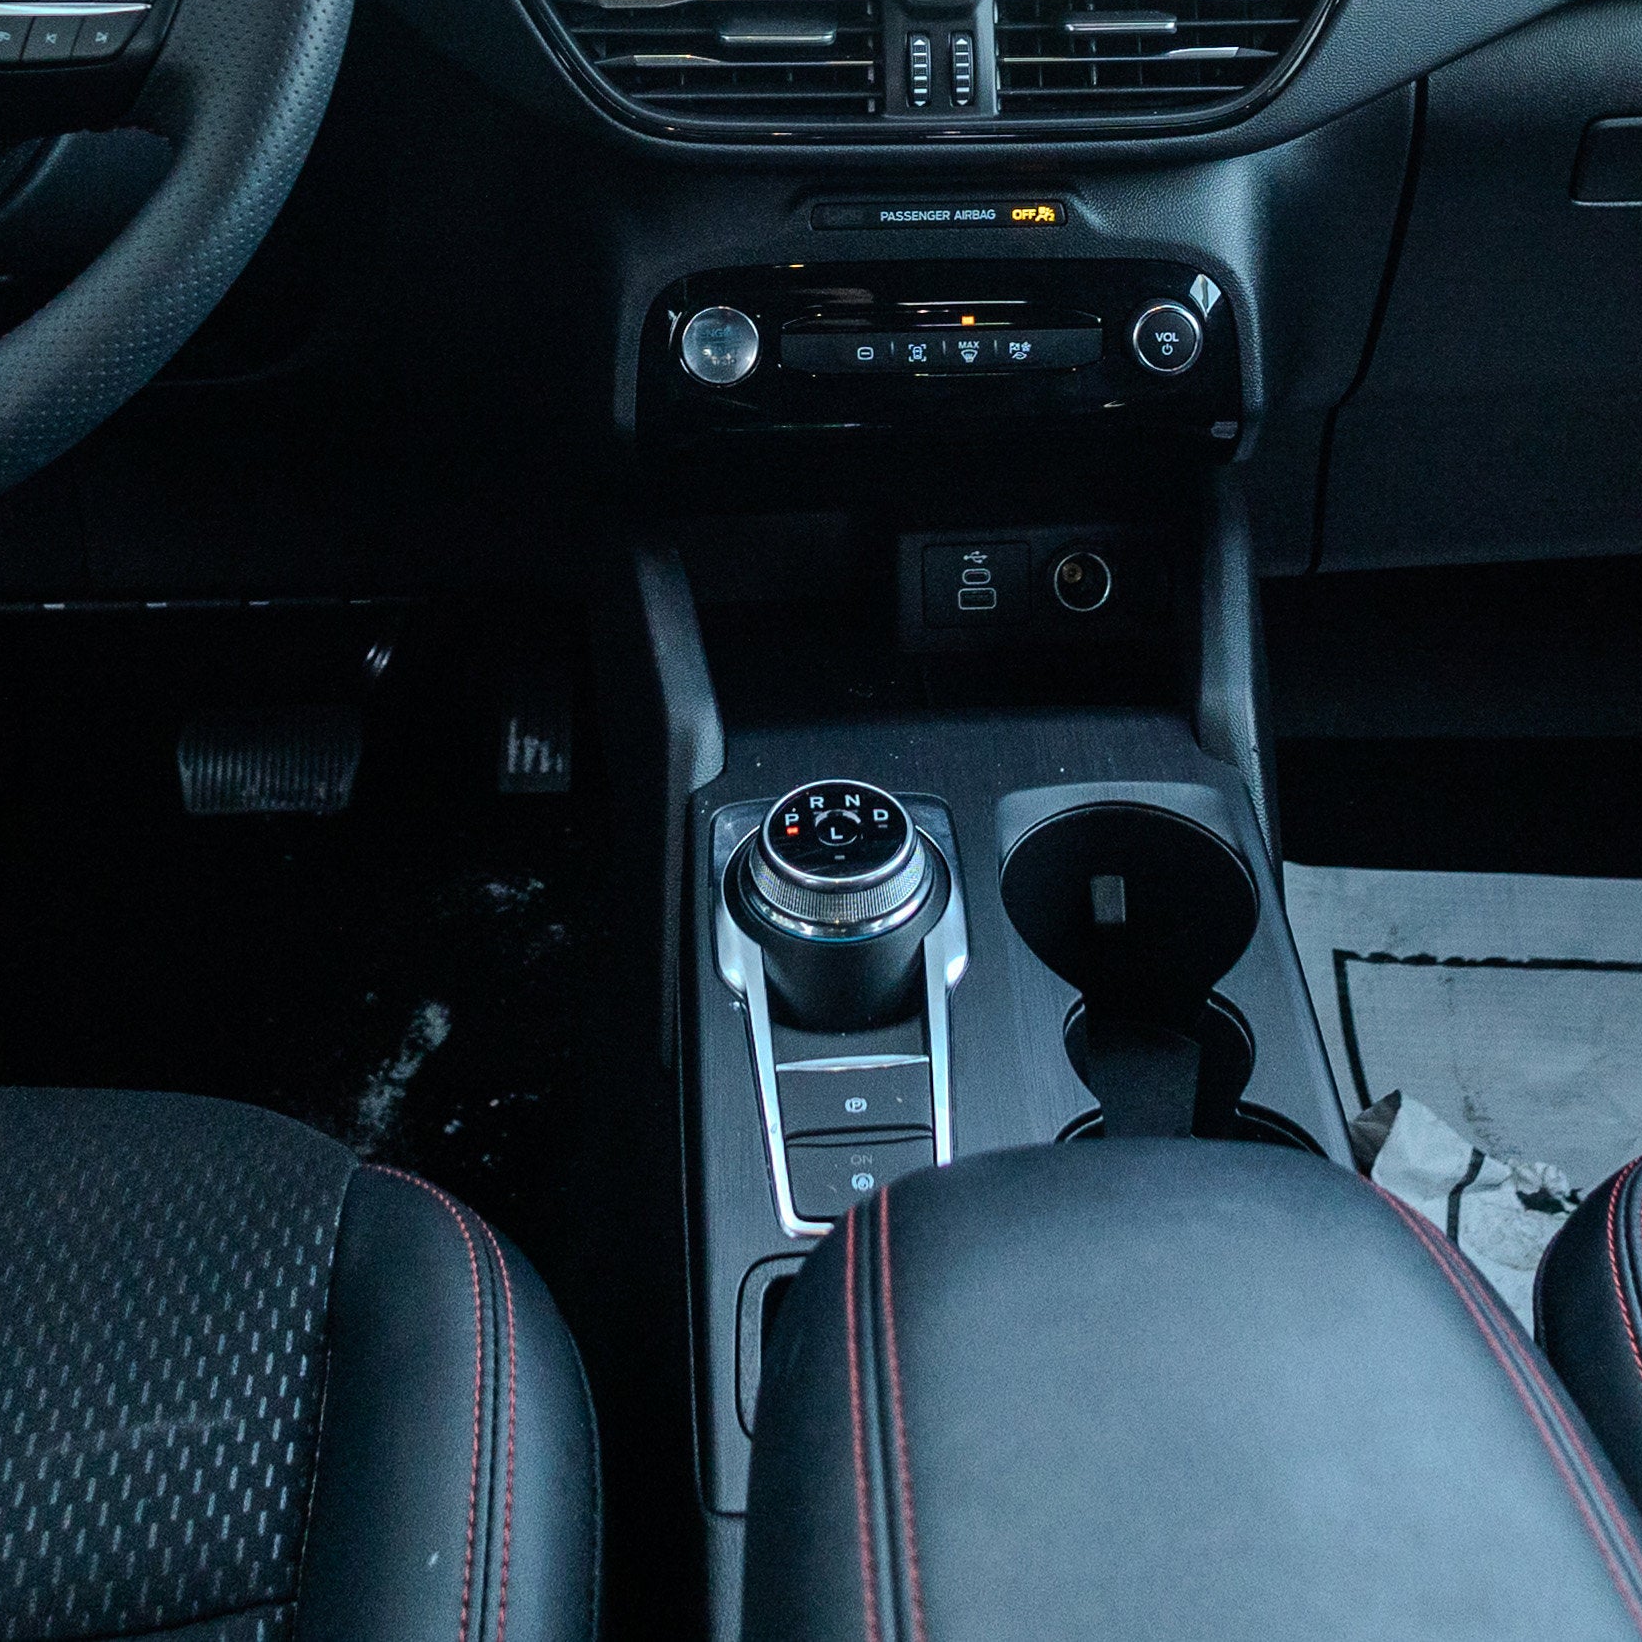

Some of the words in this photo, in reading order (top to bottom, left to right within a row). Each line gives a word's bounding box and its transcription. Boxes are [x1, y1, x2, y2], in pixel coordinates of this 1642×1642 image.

[880, 210, 950, 222] PASSENGER
[953, 209, 996, 221] AIRBAG
[1012, 208, 1036, 221] OFF
[1155, 332, 1179, 342] VOL
[958, 340, 980, 349] MAX
[785, 813, 799, 826] P
[810, 796, 824, 809] R
[844, 794, 861, 807] N
[873, 809, 889, 821] D
[830, 827, 843, 840] L
[850, 1154, 873, 1165] ON
